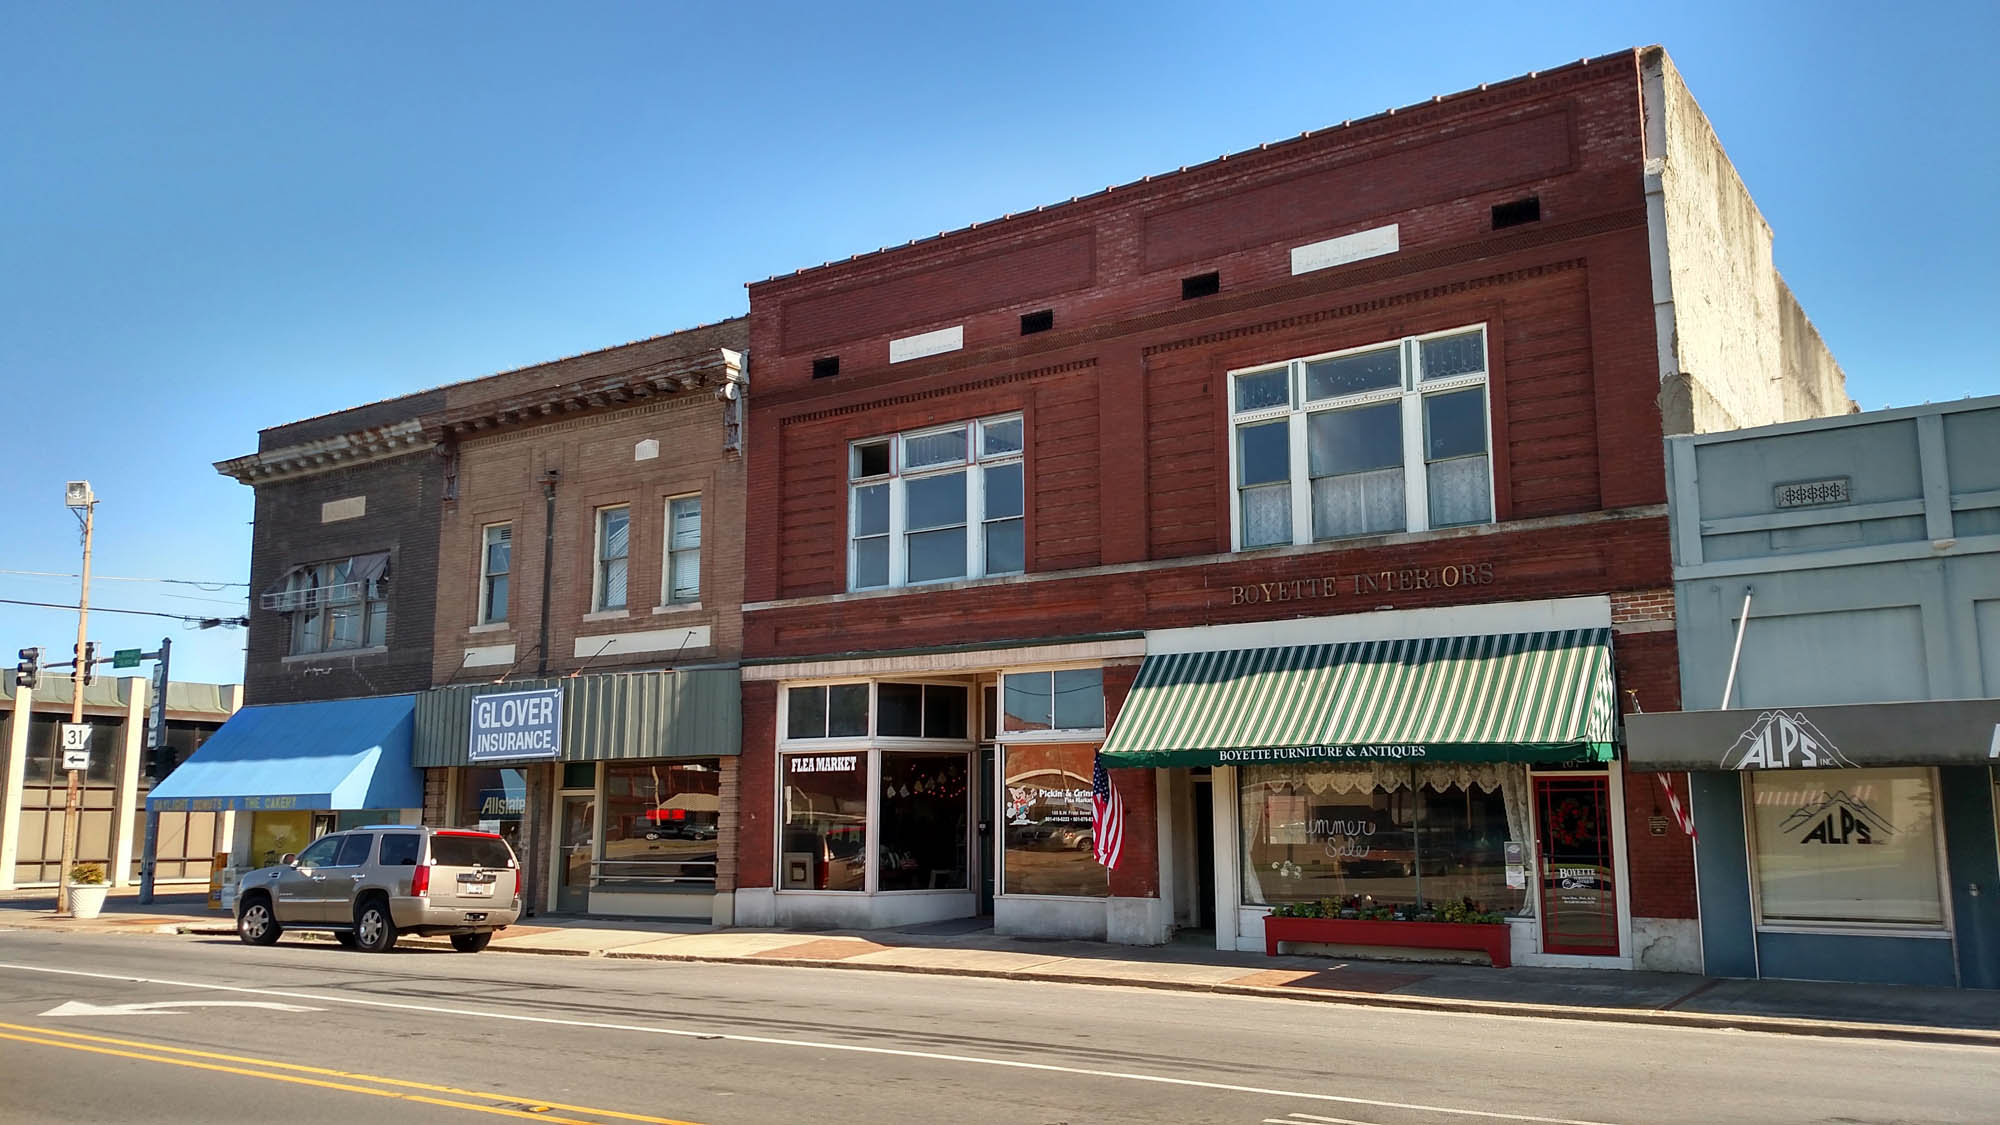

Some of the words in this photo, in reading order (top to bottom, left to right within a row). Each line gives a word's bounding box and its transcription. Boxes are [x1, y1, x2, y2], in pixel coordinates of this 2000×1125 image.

[1231, 577, 1337, 606] BOYETTE
[1353, 562, 1494, 596] INTERIORS
[478, 697, 553, 728] GLOVER
[67, 729, 82, 745] 31
[478, 731, 551, 752] INSURANCE
[1740, 718, 1817, 769] ALPS
[1219, 749, 1271, 761] BOYETTE
[1273, 746, 1344, 760] FURNITURE
[1345, 746, 1356, 757] &
[1359, 745, 1426, 758] ANTIQUES
[790, 757, 815, 773] FLEA
[815, 755, 857, 772] MARKET
[1065, 788, 1072, 797] &
[243, 796, 262, 809] THE
[265, 795, 297, 809] CAKERY
[481, 796, 526, 815] Allstate
[1303, 818, 1377, 836] ummer
[1800, 806, 1872, 845] ALPS
[1325, 836, 1370, 858] Sale
[1559, 868, 1596, 879] BOYETTE
